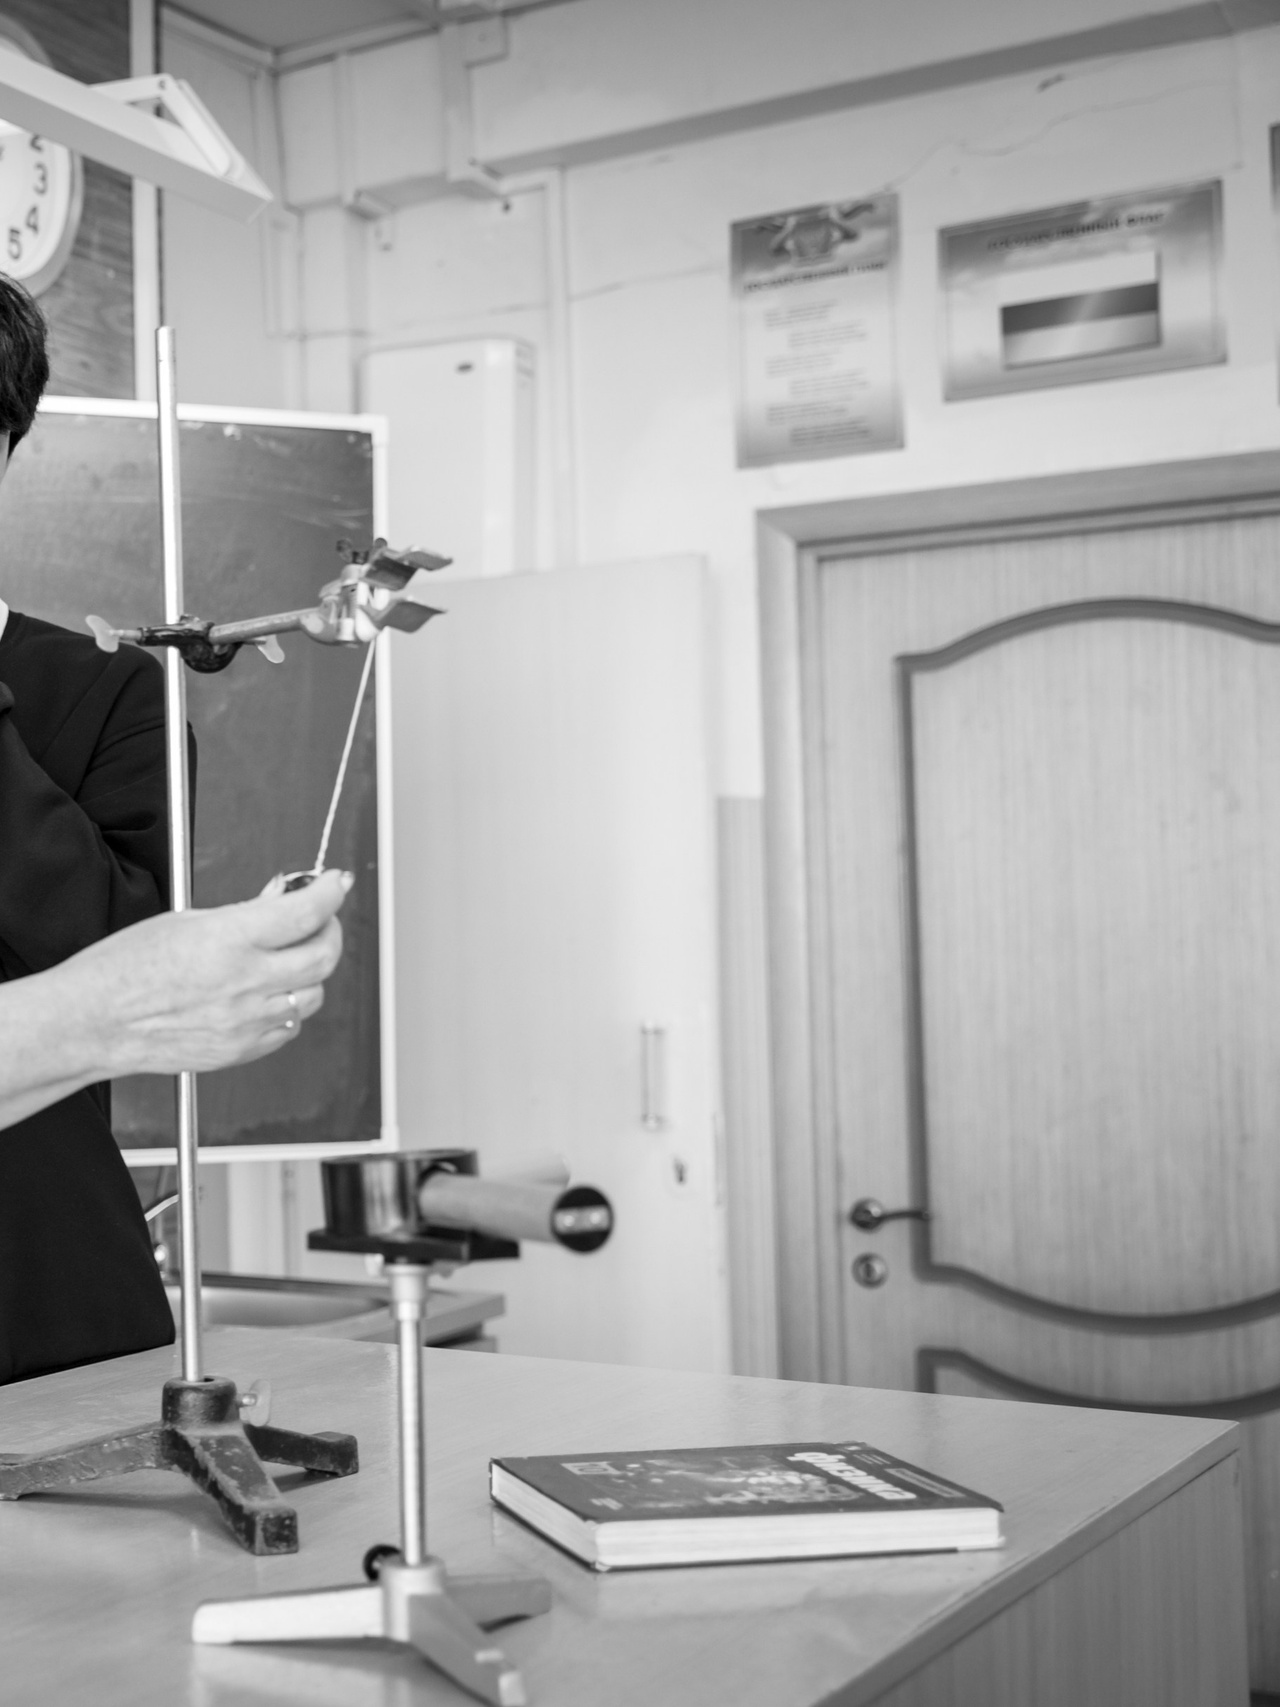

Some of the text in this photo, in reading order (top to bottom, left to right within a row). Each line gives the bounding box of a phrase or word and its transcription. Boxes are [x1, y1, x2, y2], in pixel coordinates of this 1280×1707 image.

[34, 163, 47, 195] 3
[26, 205, 39, 235] 4
[9, 227, 21, 260] 5
